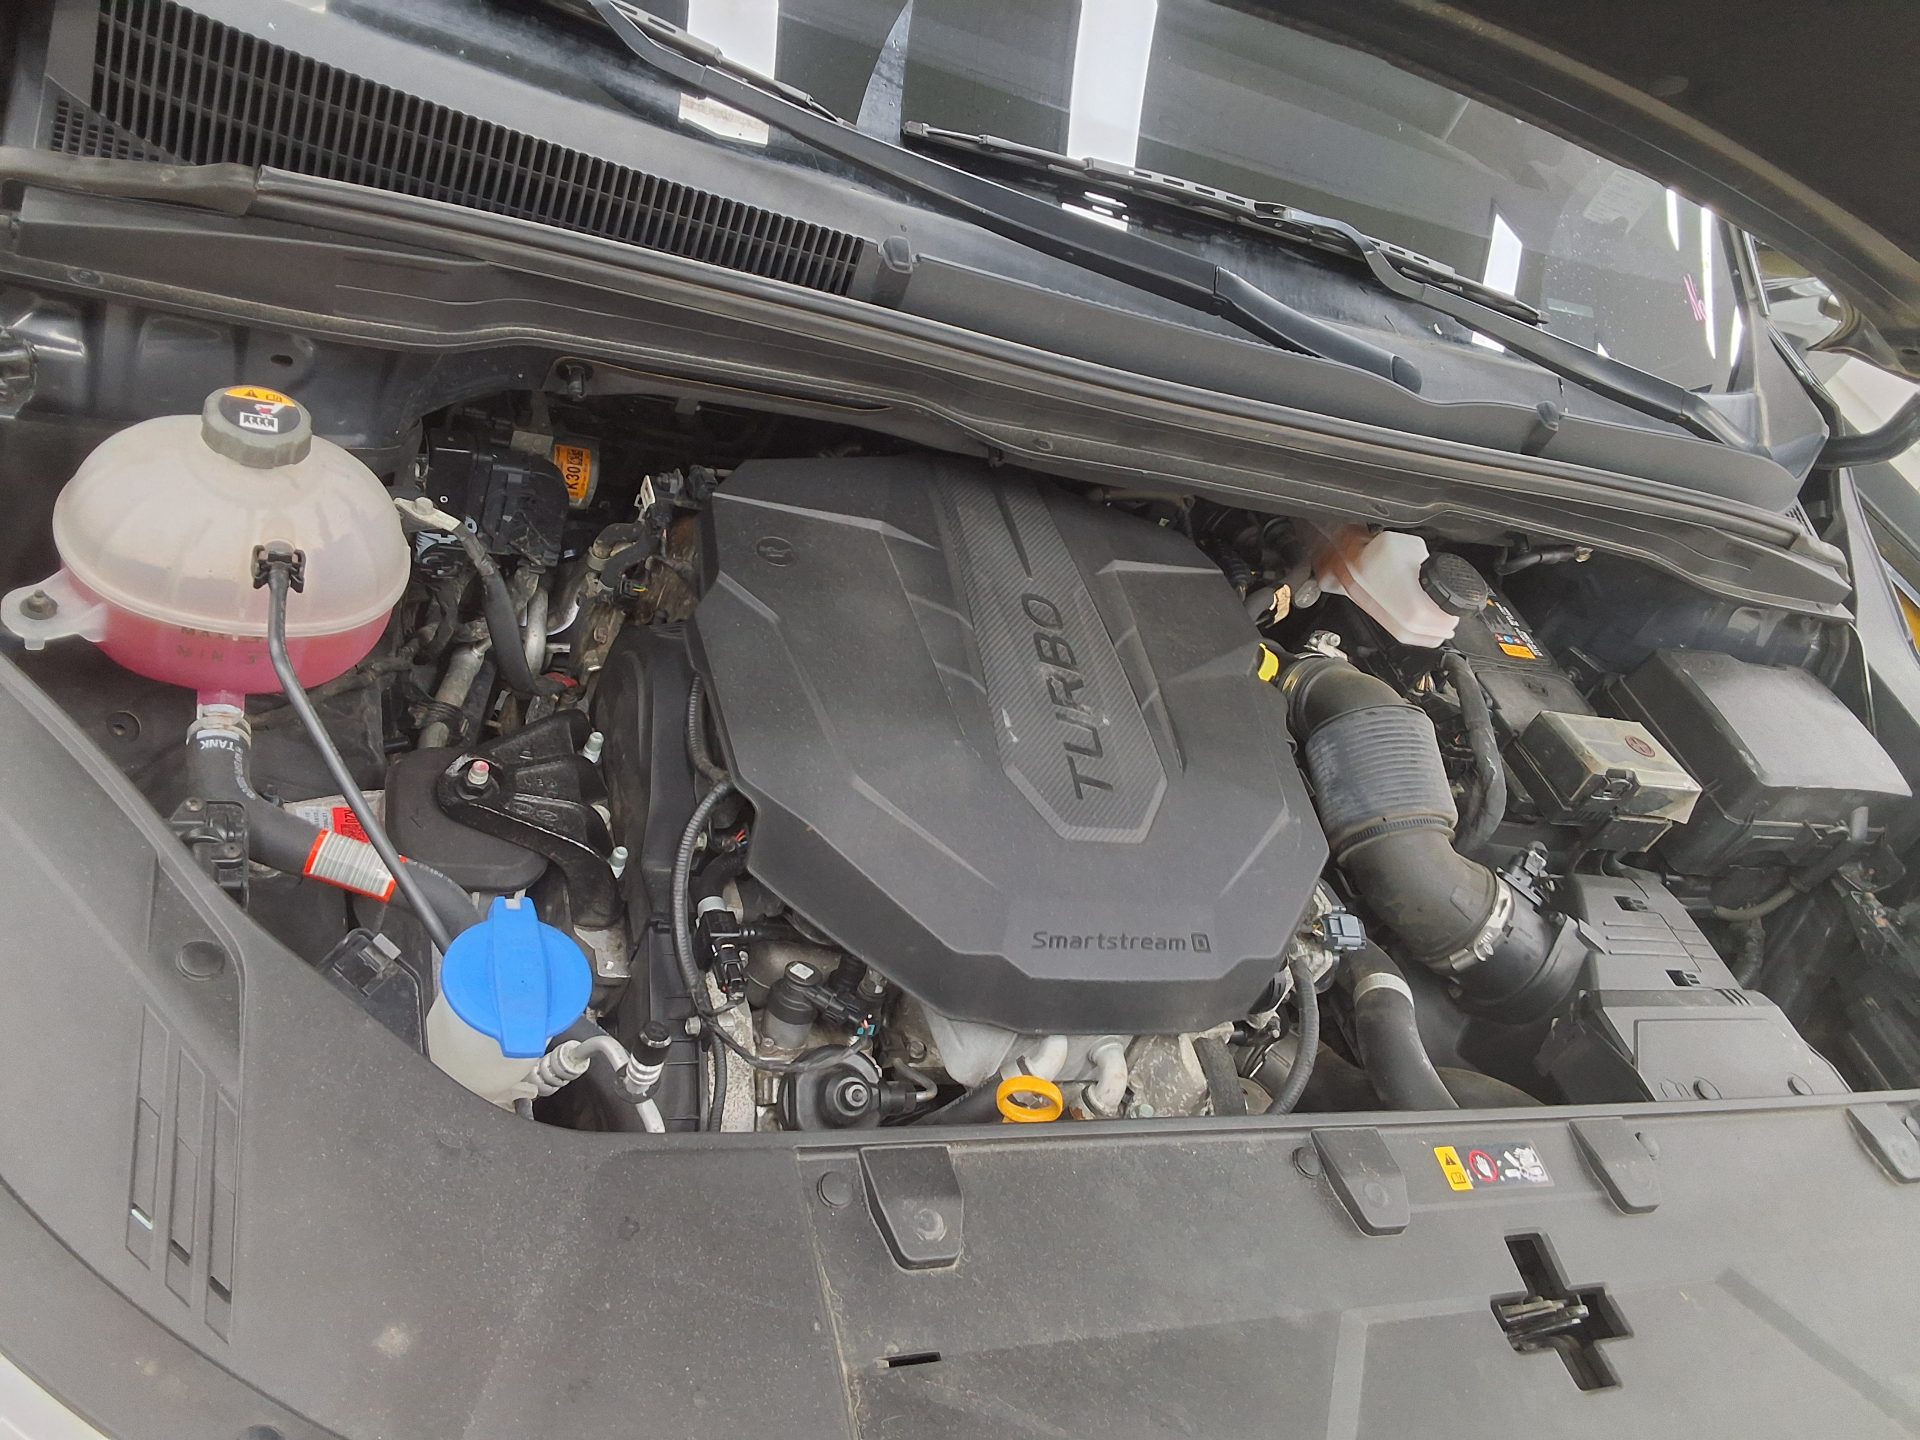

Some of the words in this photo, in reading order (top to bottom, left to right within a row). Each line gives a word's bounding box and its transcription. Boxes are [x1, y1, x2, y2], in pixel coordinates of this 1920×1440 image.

[1020, 592, 1114, 801] TURBO
[200, 739, 236, 752] TANK
[1031, 931, 1187, 951] Smartstream
